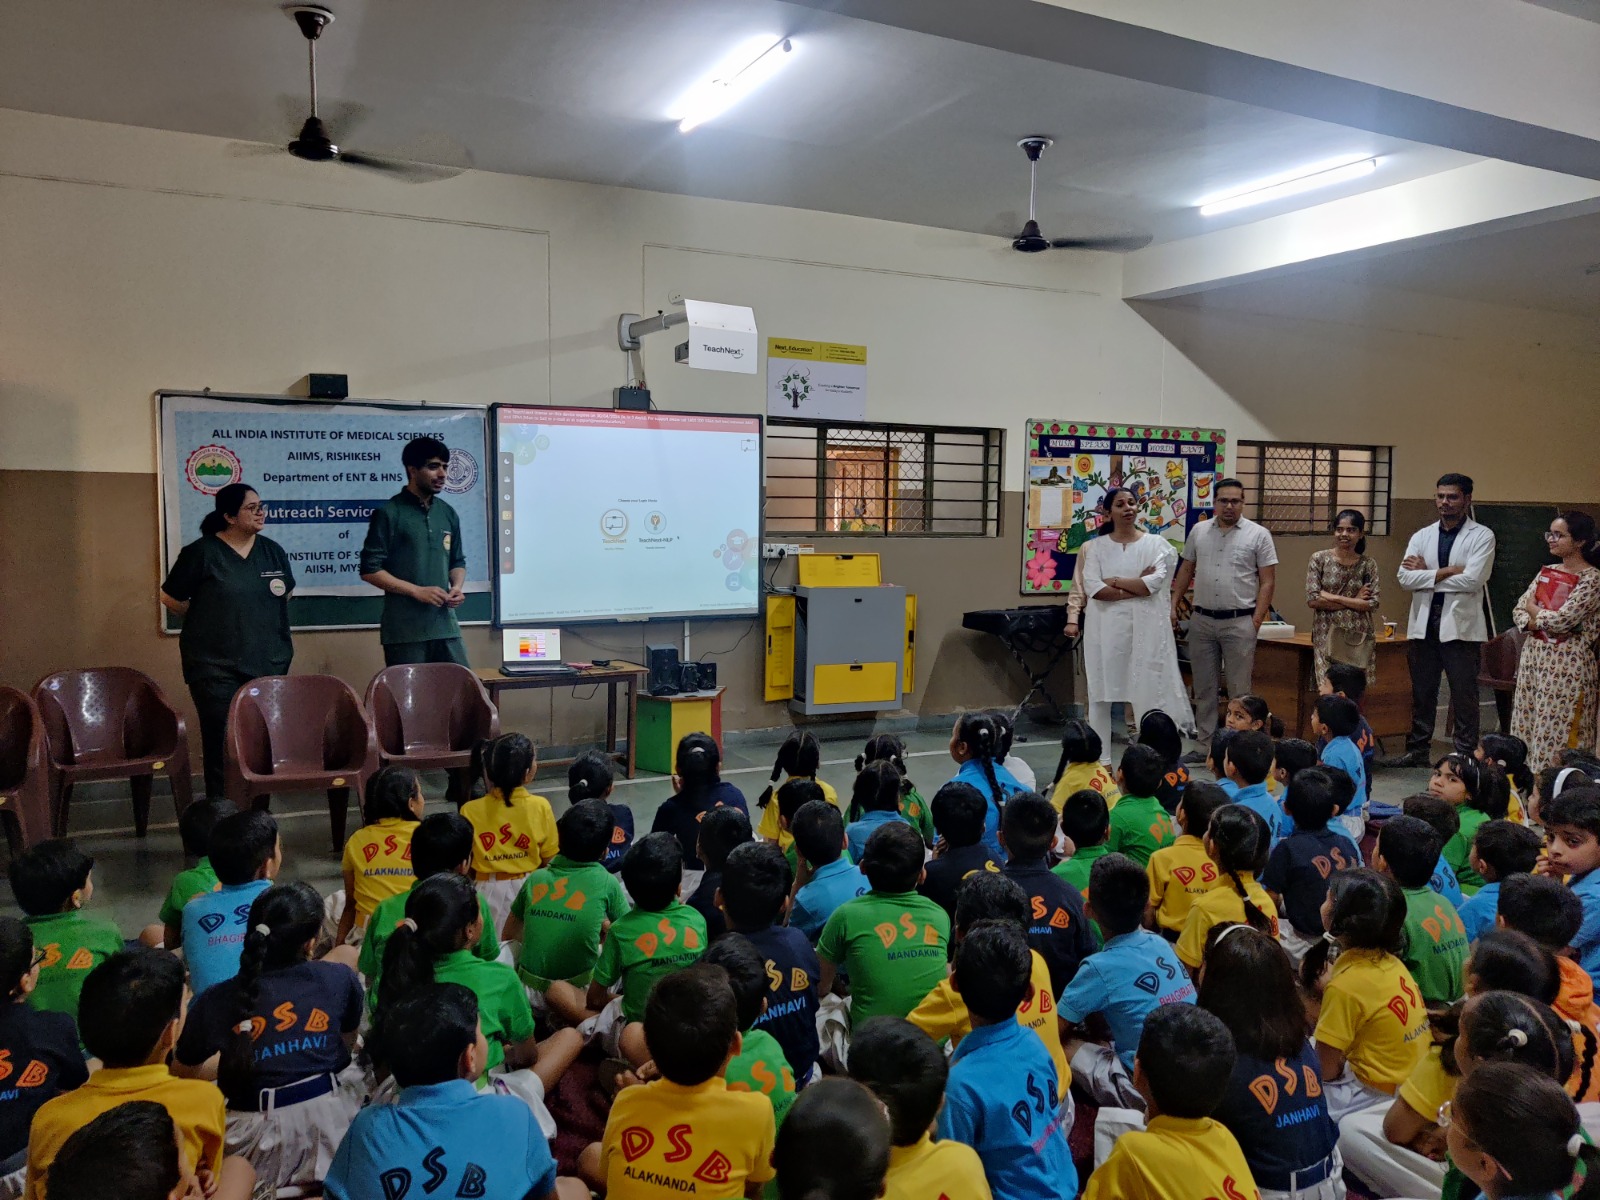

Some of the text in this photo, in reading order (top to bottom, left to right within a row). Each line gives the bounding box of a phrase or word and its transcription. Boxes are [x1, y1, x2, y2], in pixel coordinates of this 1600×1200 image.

[703, 344, 741, 355] TeachNext
[212, 429, 445, 441] ALL INDIA INSTITUTE OF MEDICAL SCIENCES
[1080, 440, 1110, 449] SPEAKS
[1116, 443, 1141, 452] WHEN
[1148, 443, 1175, 453] WORDS
[288, 451, 381, 462] AIIMS, RISHIKESH
[263, 473, 403, 484] Department of ENT & HNS
[338, 530, 350, 539] of
[337, 551, 352, 560] OF
[305, 564, 337, 575] AIISH,
[1164, 767, 1188, 788] DS
[479, 822, 531, 852] DSB
[484, 851, 529, 862] ALAKNANDA
[363, 867, 415, 877] ALAKNAND
[1172, 862, 1217, 886] DS
[1184, 887, 1209, 895] ALAKNA
[530, 908, 577, 922] MANDAKINI
[1030, 895, 1070, 929] SB
[874, 912, 939, 949] DSB
[1028, 926, 1053, 935] NHAVI
[207, 933, 246, 947] BHAGIR
[39, 942, 94, 969] SB
[650, 951, 701, 967] MANDAKIN
[887, 948, 940, 961] MANDAKINI
[764, 958, 810, 992] SB
[254, 1034, 327, 1063] JANHAVI
[1248, 1056, 1322, 1116] DSB
[1275, 1103, 1321, 1129] JANHAVI
[621, 1123, 732, 1185] DSB
[623, 1165, 697, 1194] ALAKNANDA
